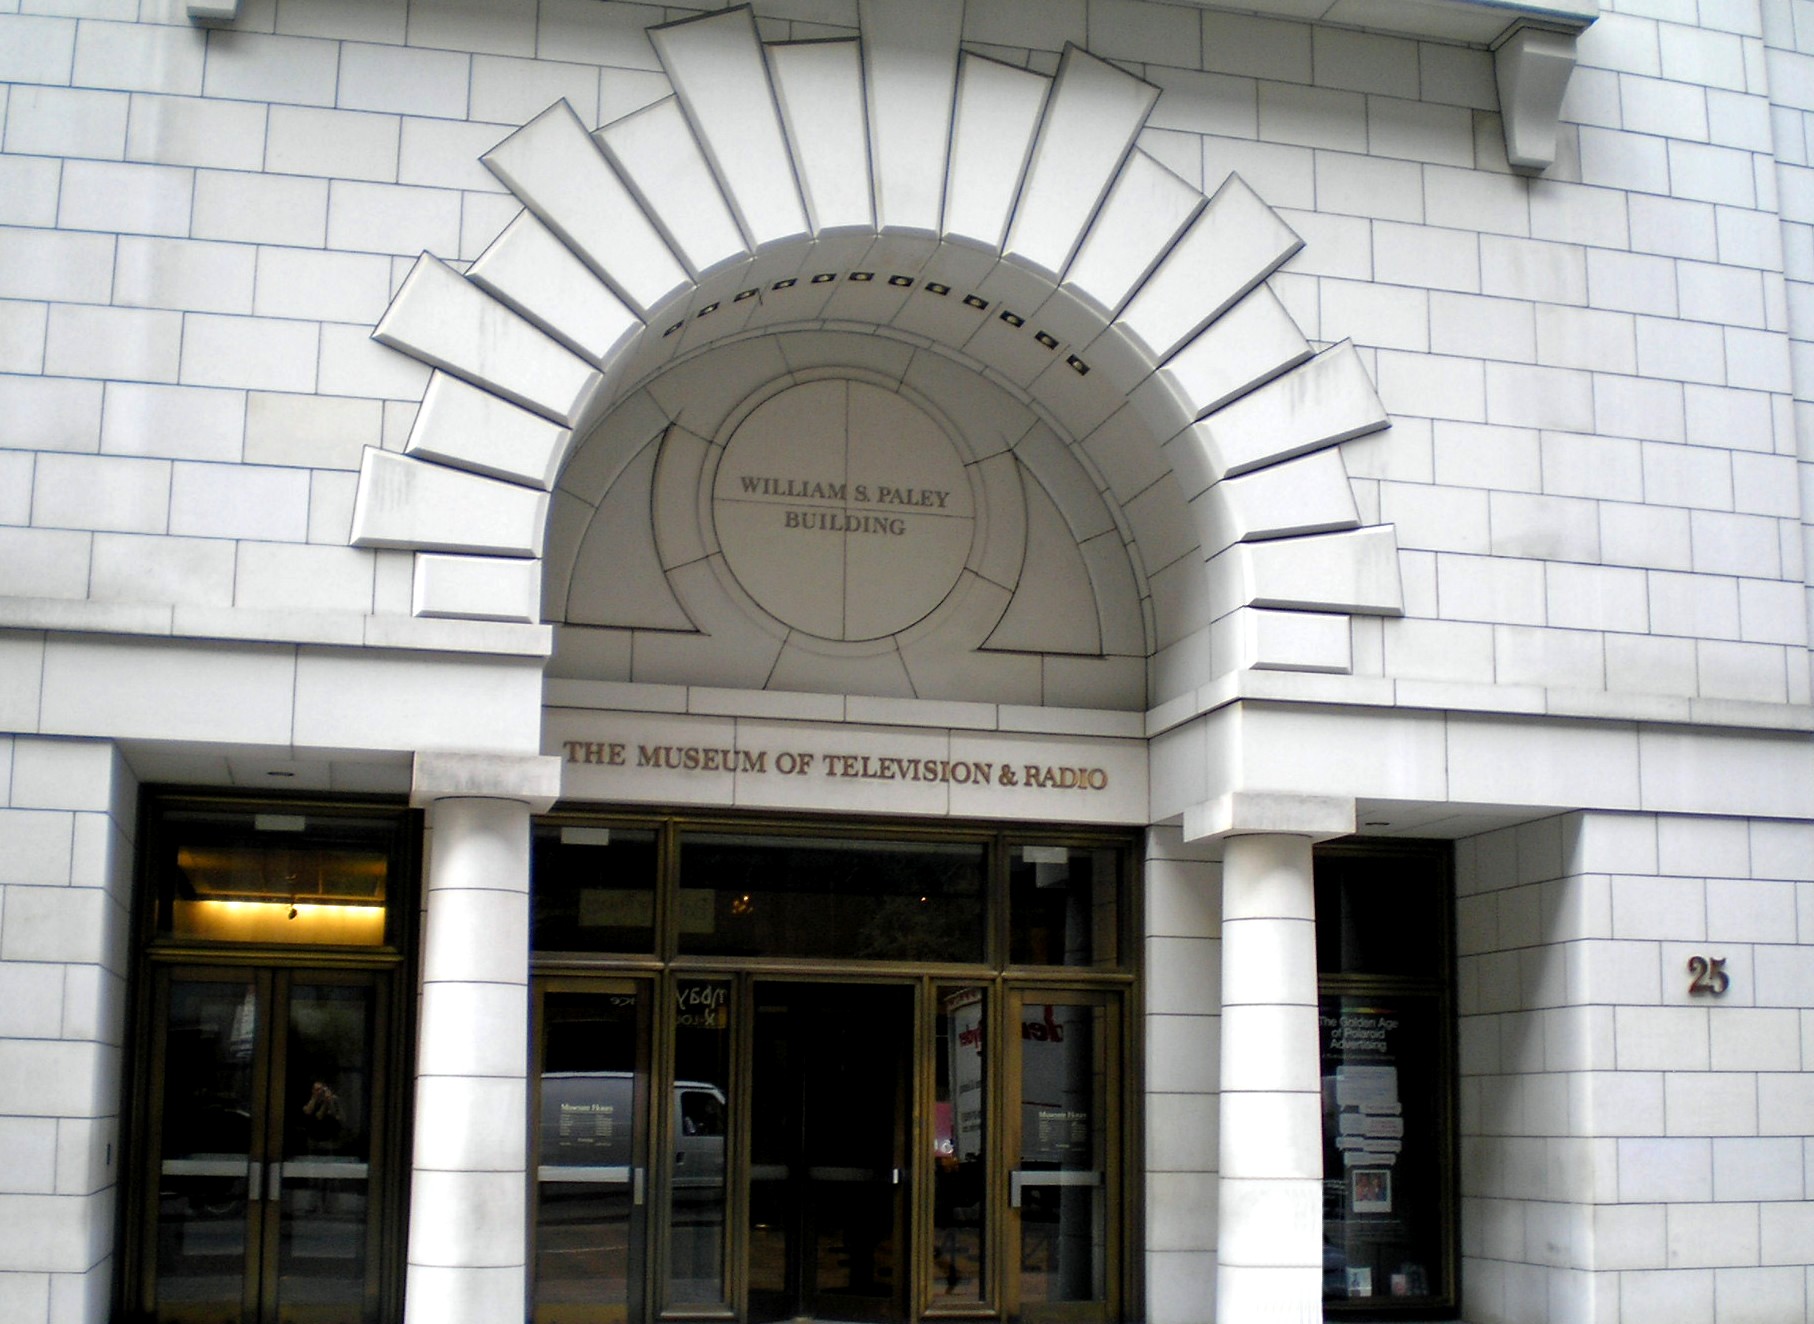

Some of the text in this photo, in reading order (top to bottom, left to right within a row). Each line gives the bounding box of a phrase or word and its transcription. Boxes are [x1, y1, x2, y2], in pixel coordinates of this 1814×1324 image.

[741, 476, 950, 508] WILLIAM S. PALEY
[784, 511, 906, 535] BUILDING
[563, 741, 1108, 790] THE MUSEUM OF TELEVISION & RADIO
[1688, 956, 1730, 997] 25
[1319, 1016, 1337, 1027] The
[1377, 1018, 1399, 1030] Age
